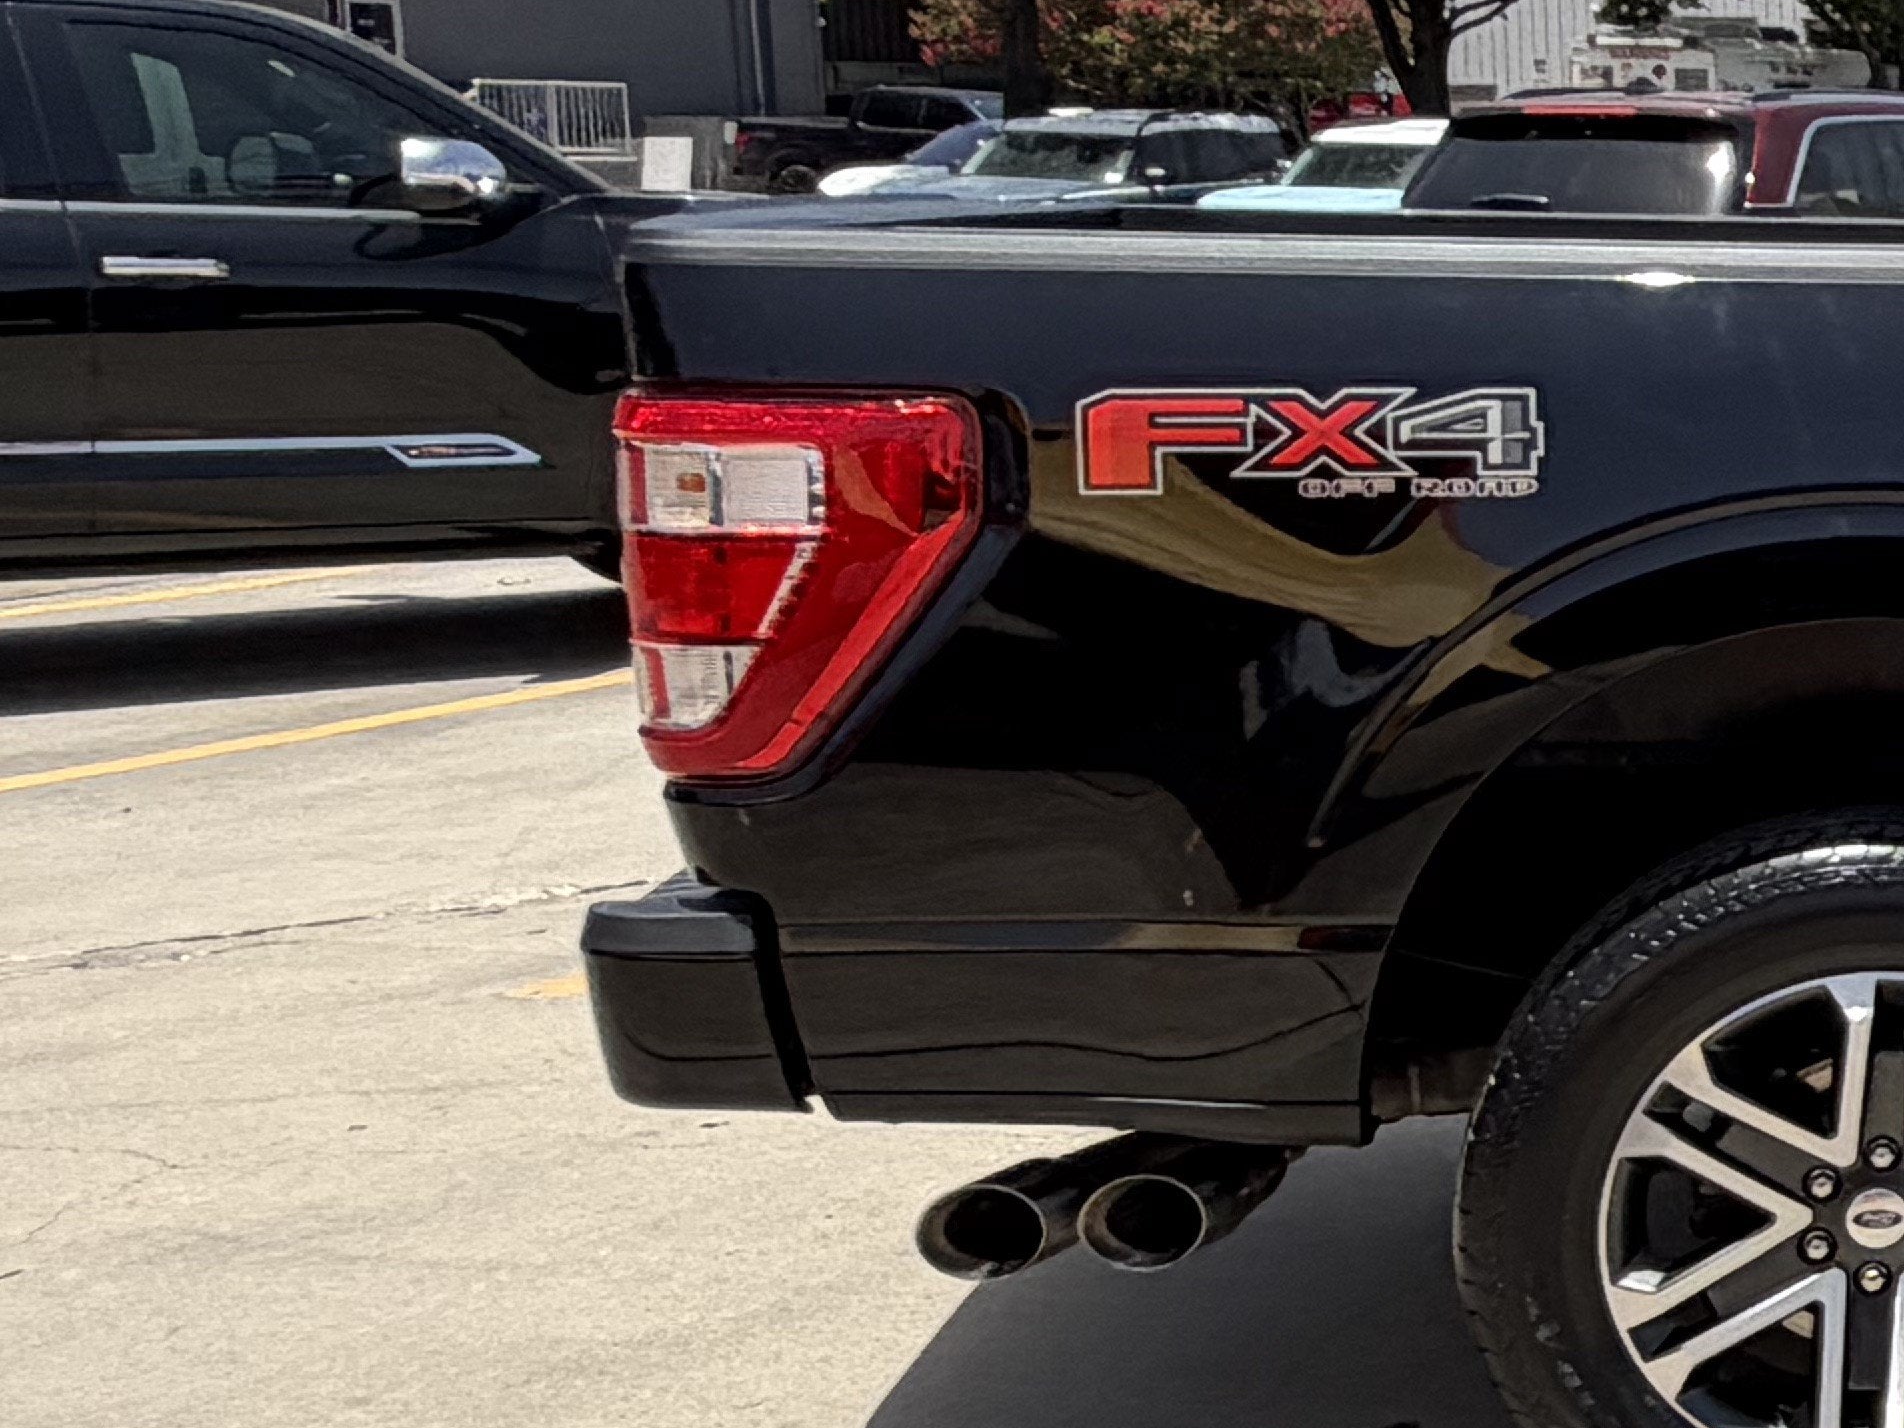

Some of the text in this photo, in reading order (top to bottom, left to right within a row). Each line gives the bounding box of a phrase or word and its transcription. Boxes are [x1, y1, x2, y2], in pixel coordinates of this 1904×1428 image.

[1077, 387, 1544, 494] FX4
[1299, 477, 1539, 498] OFF ROAD
